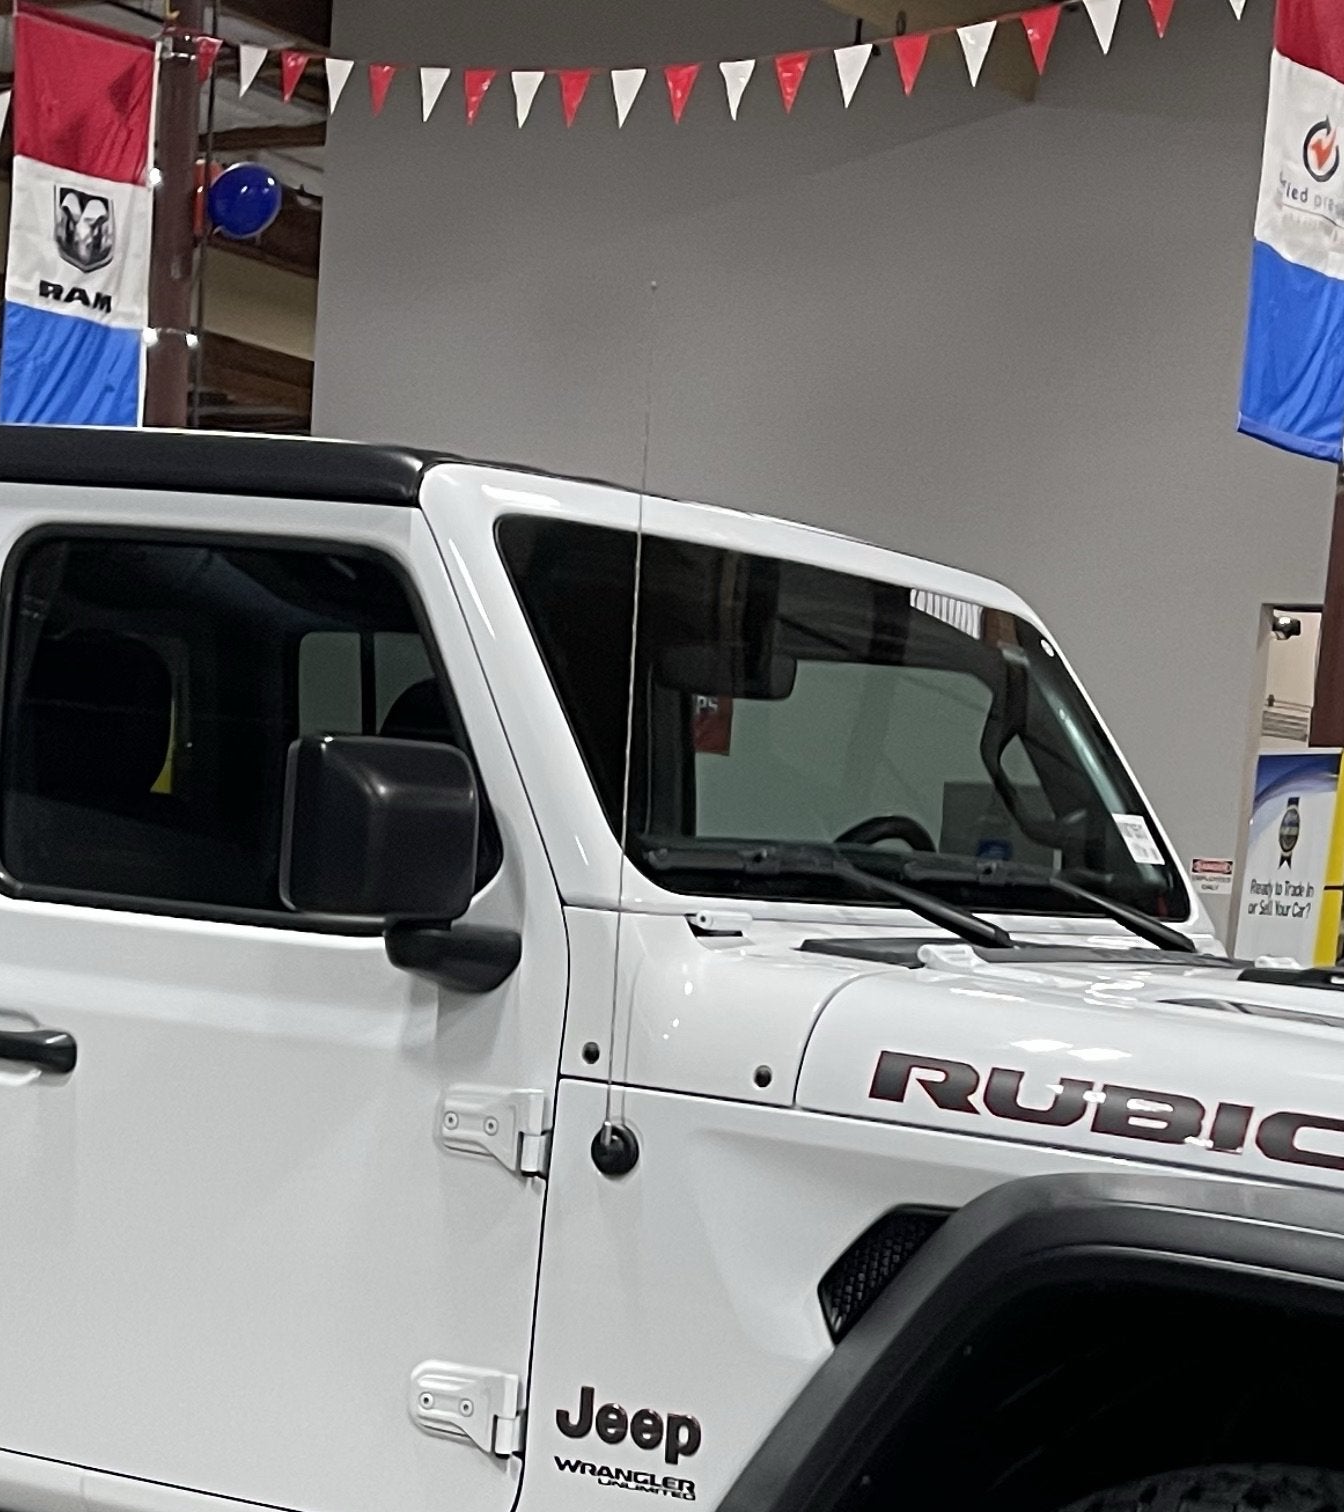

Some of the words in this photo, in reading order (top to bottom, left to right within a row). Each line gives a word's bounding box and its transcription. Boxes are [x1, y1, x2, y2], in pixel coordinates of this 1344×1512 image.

[39, 279, 113, 314] RAM
[1250, 878, 1273, 898] Ready
[1274, 881, 1283, 896] to
[1284, 880, 1304, 898] Trade
[1247, 902, 1259, 915] or
[1259, 899, 1273, 916] Sell
[1275, 901, 1292, 917] Your
[555, 1385, 702, 1466] Jeep
[553, 1454, 696, 1494] WRANGLER
[597, 1476, 697, 1502] UNLIMITED
